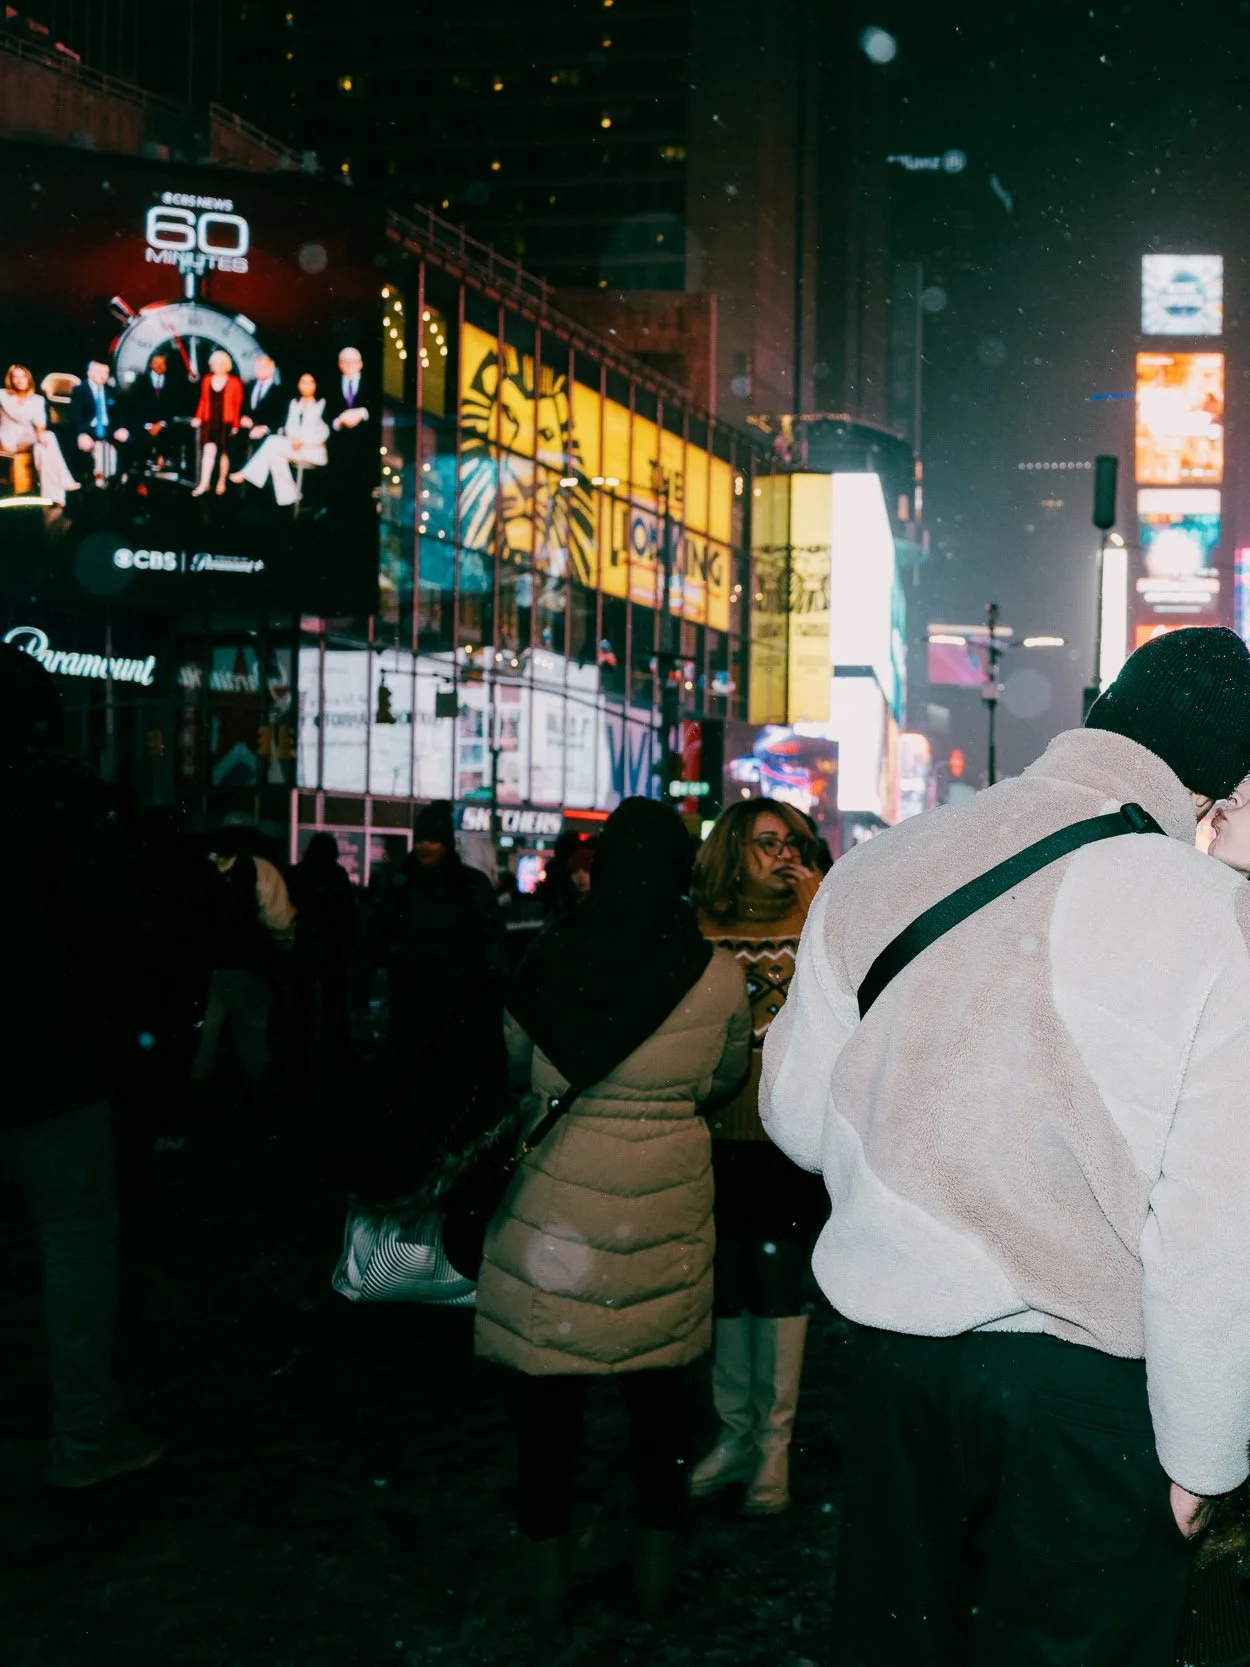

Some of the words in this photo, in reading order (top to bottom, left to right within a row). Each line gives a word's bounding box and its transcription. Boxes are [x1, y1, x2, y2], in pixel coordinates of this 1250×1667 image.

[172, 193, 197, 208] CBS
[196, 196, 234, 212] NEWS
[146, 205, 250, 257] 60
[145, 247, 249, 274] MINUTES
[133, 549, 177, 572] CBS
[461, 806, 562, 834] SKCHERS
